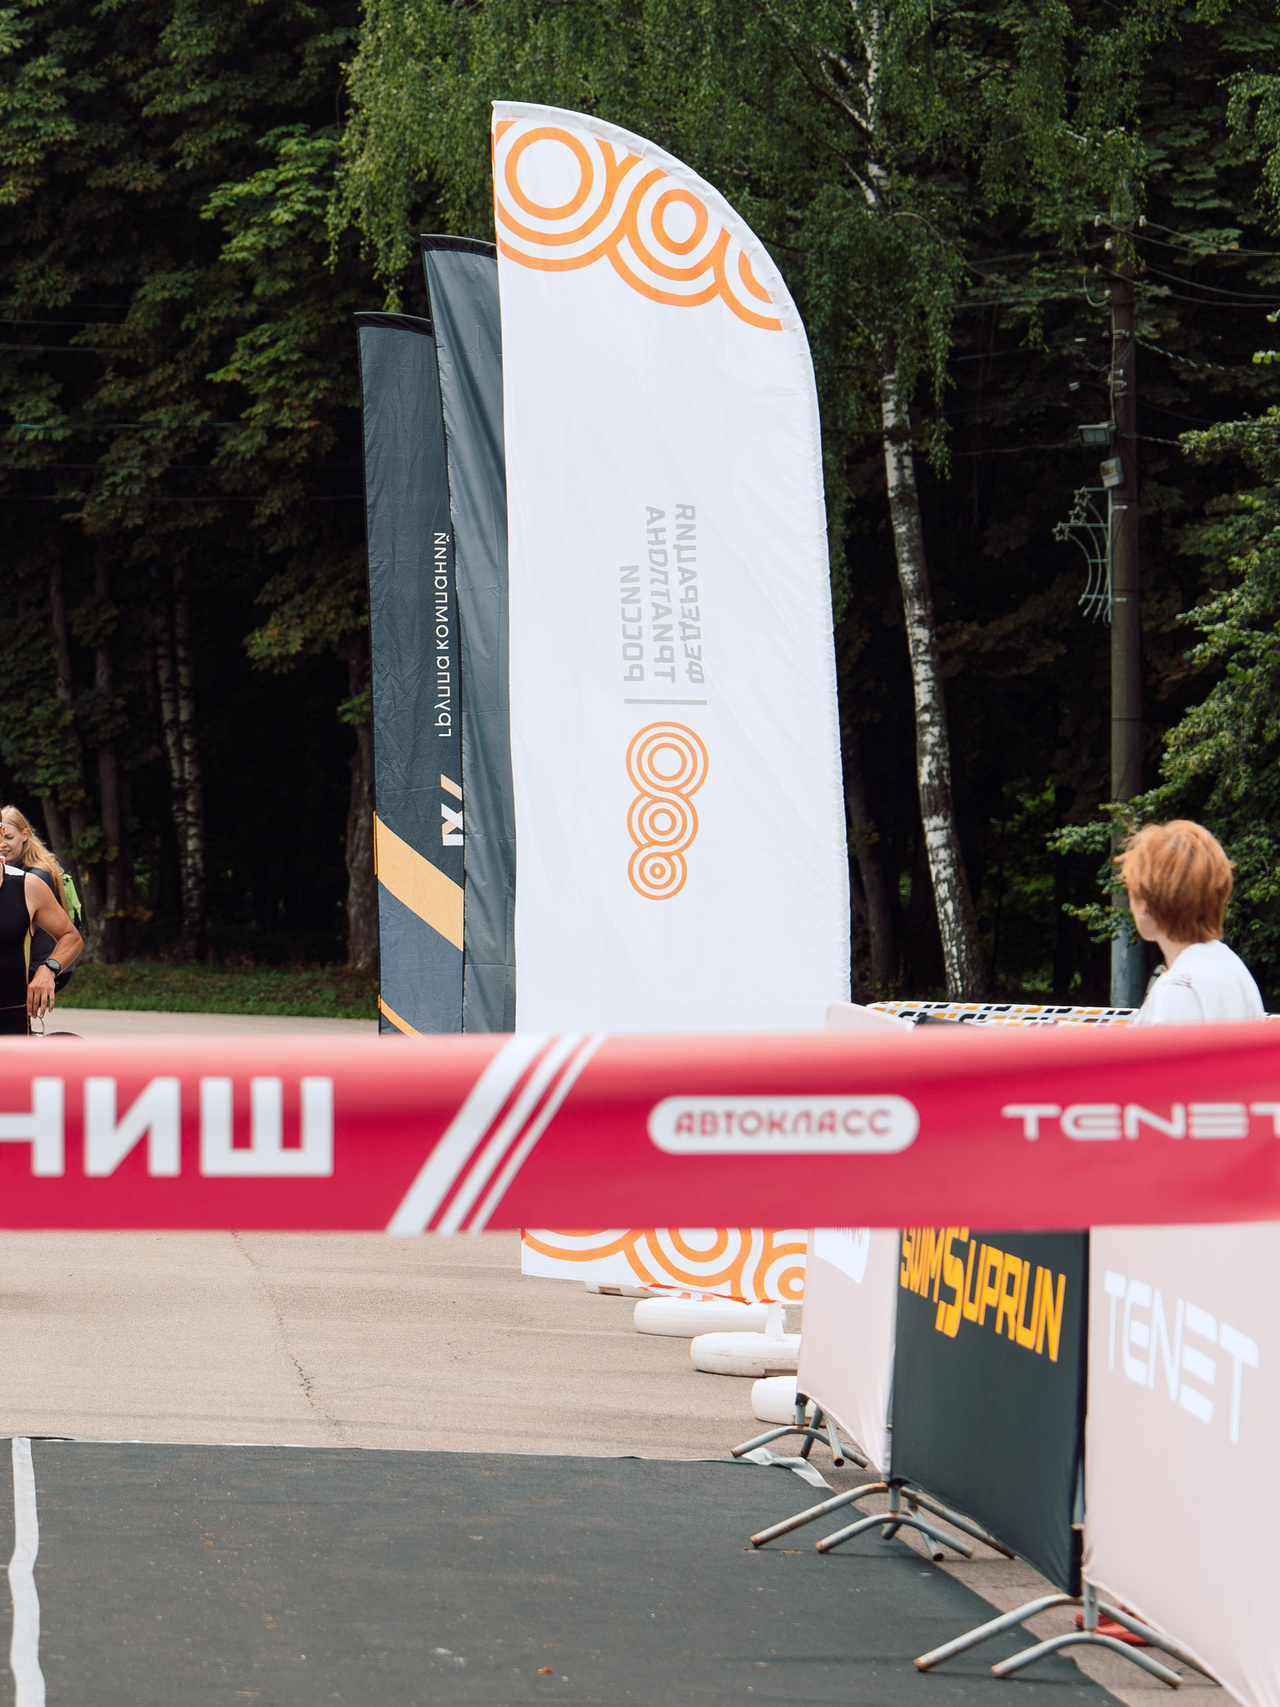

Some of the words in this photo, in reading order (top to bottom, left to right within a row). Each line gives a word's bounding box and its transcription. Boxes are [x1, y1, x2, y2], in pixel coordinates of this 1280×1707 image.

[675, 1108, 893, 1137] АВТОКЛАСС
[899, 1226, 1067, 1363] SWIMSUPRUN
[1103, 1269, 1260, 1444] TENET
